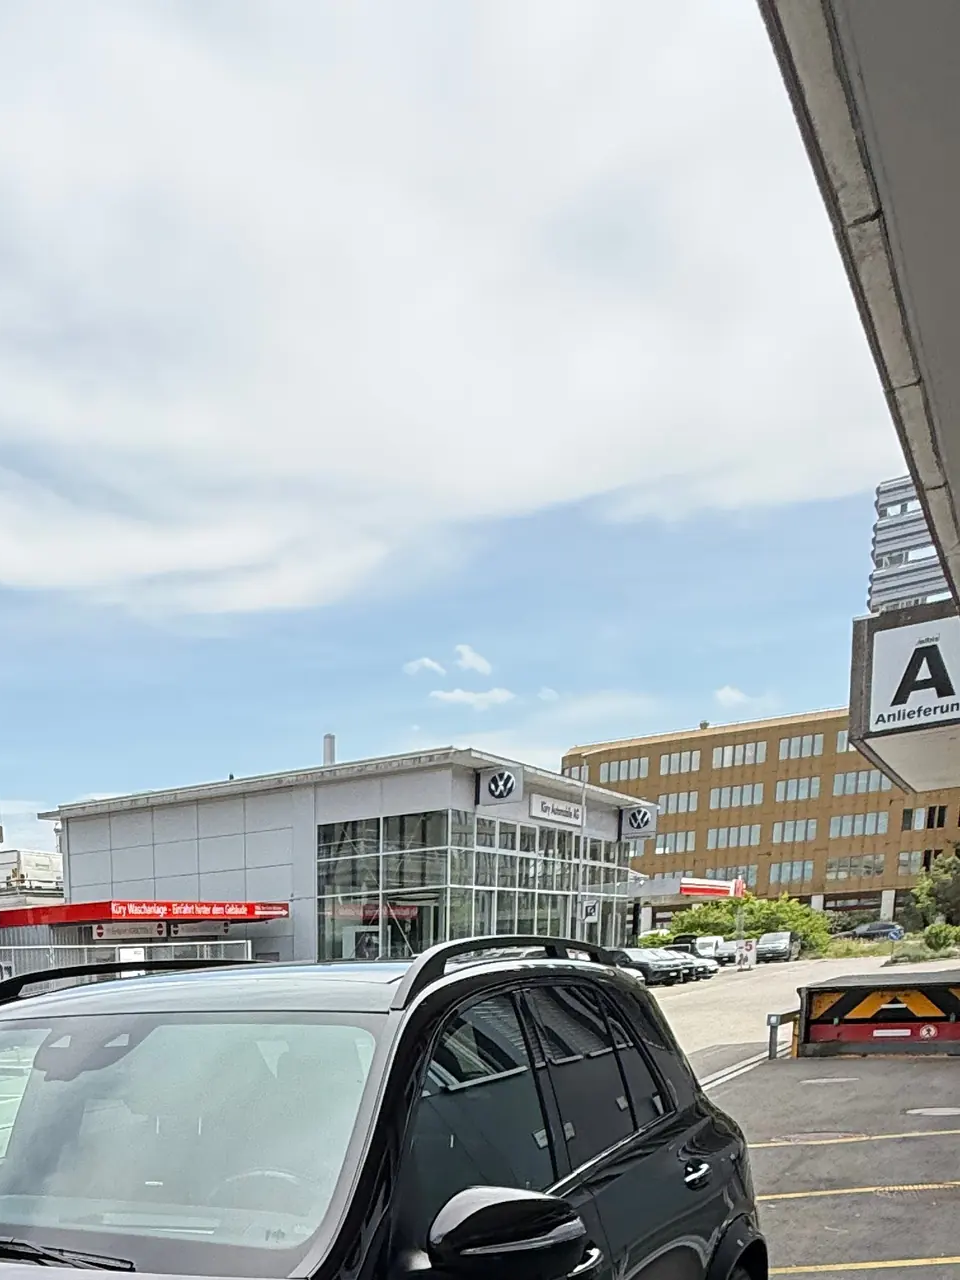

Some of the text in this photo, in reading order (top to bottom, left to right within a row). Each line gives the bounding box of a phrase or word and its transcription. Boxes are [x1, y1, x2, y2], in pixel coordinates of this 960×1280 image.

[890, 644, 956, 707] A
[573, 807, 580, 820] AG
[127, 903, 168, 917] Waschanlage
[172, 903, 194, 915] Einfahrt
[212, 904, 224, 915] dem
